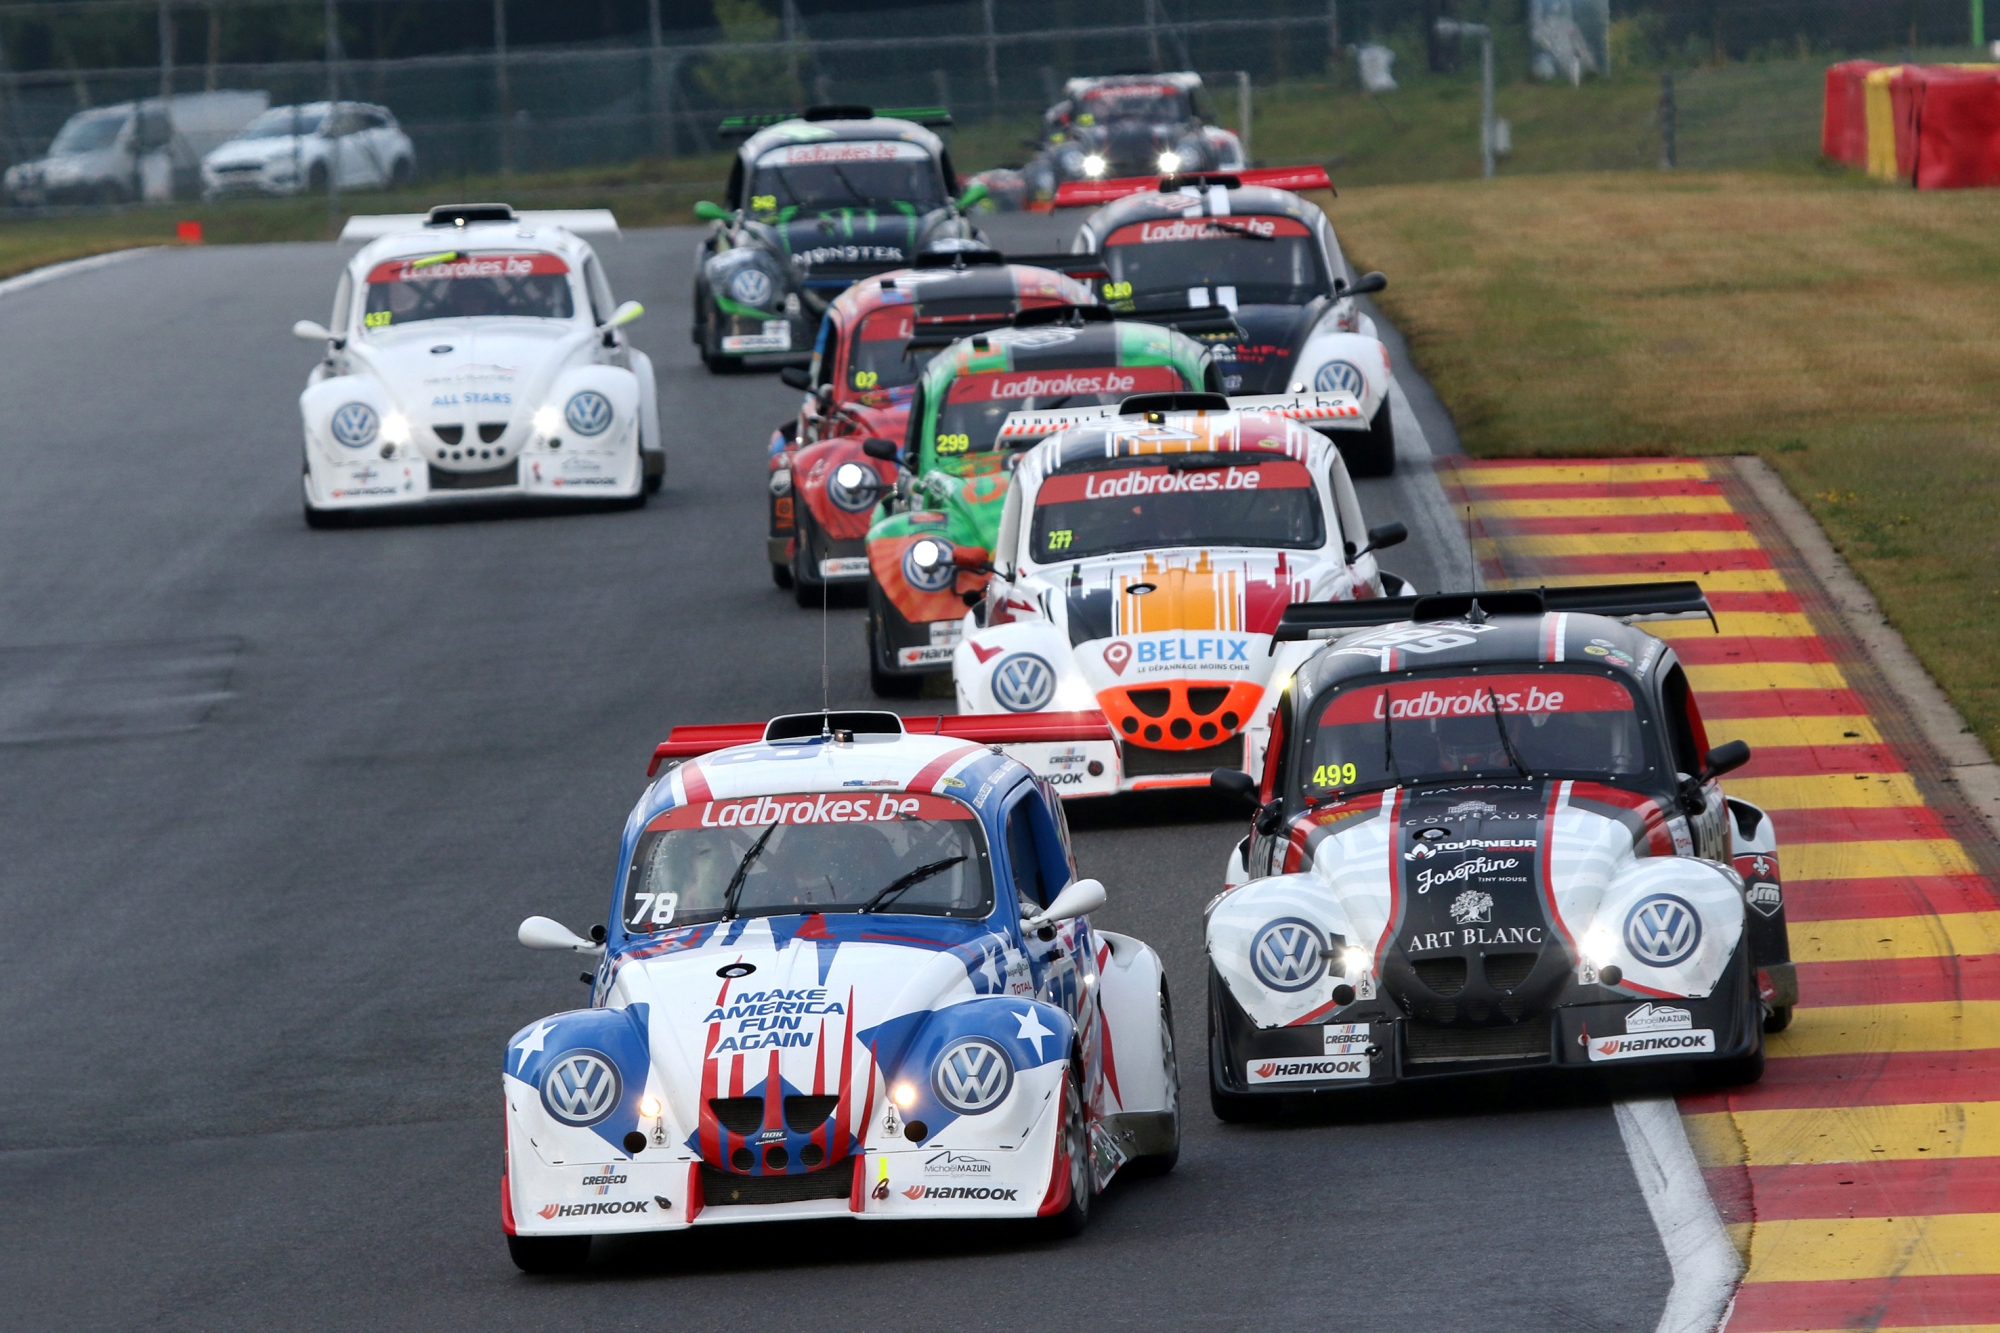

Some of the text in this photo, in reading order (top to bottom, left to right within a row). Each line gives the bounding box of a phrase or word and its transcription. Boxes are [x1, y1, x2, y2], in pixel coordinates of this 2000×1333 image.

[1141, 217, 1276, 241] Ladbrokbe
[365, 311, 392, 327] 437
[855, 371, 878, 389] 02
[991, 373, 1135, 399] Ladbrokes.be
[432, 392, 512, 406] ALL STARS
[937, 433, 969, 452] 299
[1085, 467, 1260, 499] Ladbrokes.be
[1048, 530, 1072, 549] 277
[1137, 639, 1249, 662] BELFIX
[1148, 663, 1198, 672] DÉPANNAGE
[1374, 685, 1564, 720] Ladbrokes.be
[1313, 763, 1357, 787] 499
[700, 793, 920, 828] Ladbrokes.be
[1433, 838, 1538, 851] TOURNEUR
[1416, 856, 1519, 894] Josephine
[630, 892, 678, 925] 78
[1408, 927, 1542, 953] ART BLANC
[734, 989, 828, 1004] MAKE
[1011, 980, 1033, 995] TOTAL
[702, 1001, 845, 1023] AMERICA
[738, 1015, 803, 1033] FUN
[715, 1031, 814, 1053] AGAIN
[1325, 1033, 1369, 1044] CREDECO
[582, 1175, 627, 1186] CREDECO
